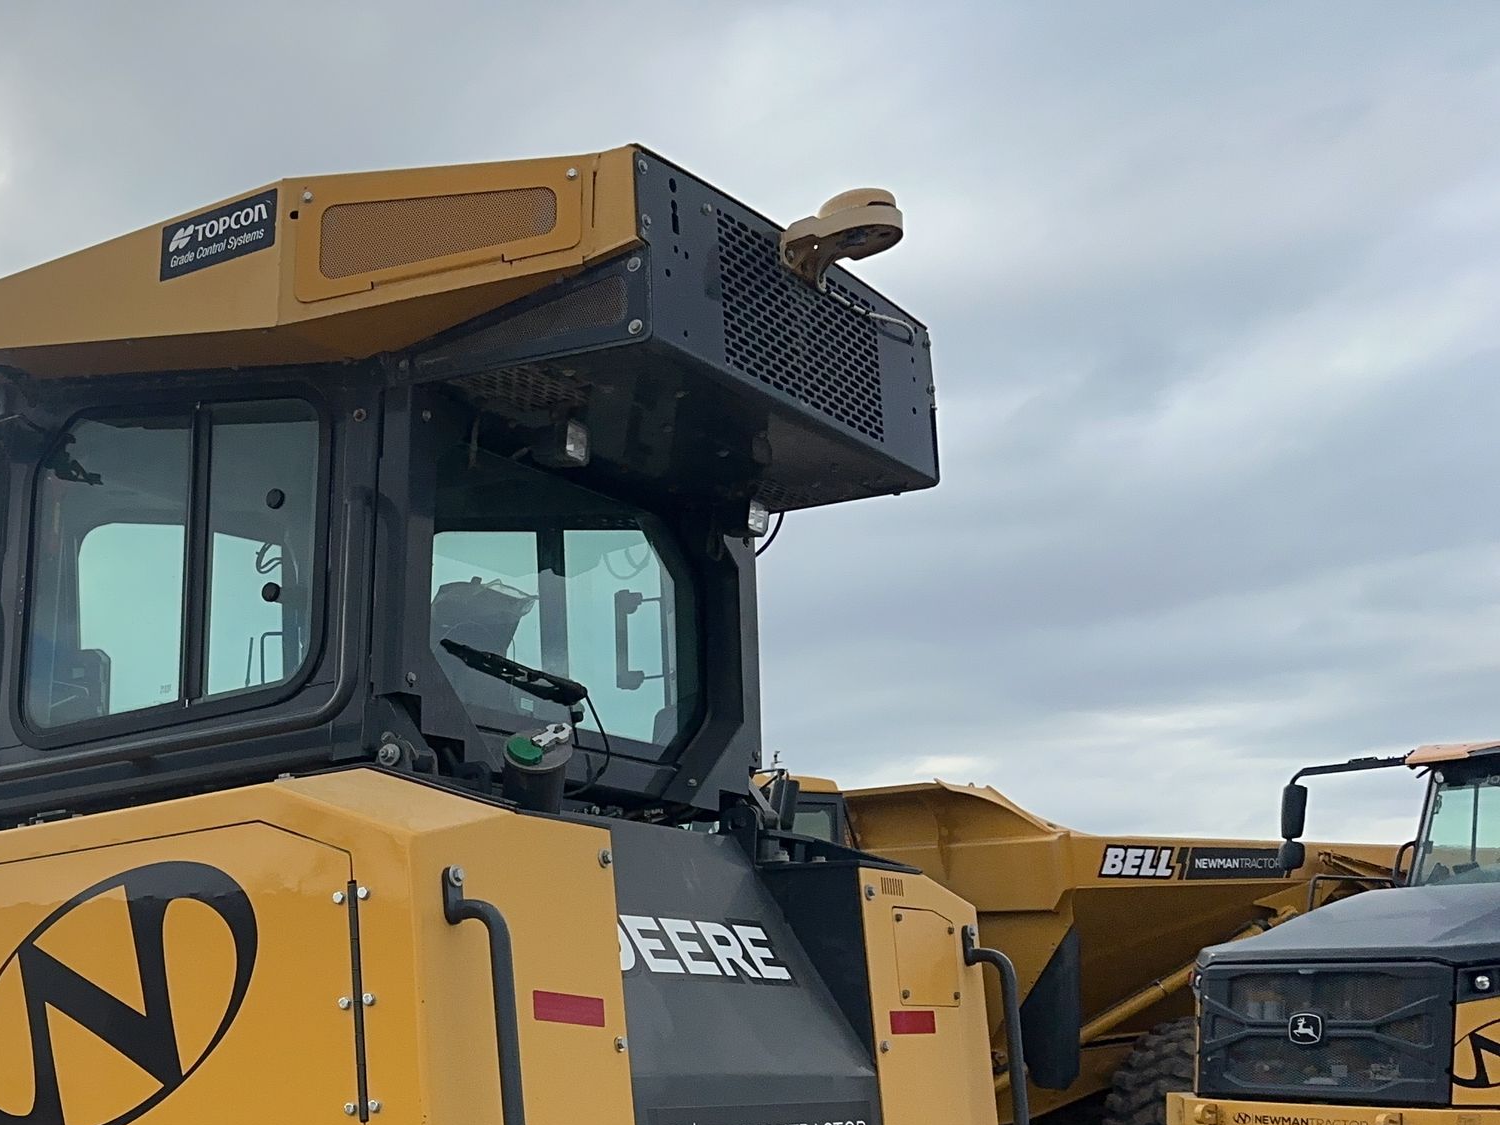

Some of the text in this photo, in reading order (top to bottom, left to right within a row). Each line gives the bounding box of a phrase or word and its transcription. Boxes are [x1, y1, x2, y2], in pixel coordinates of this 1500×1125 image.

[195, 203, 268, 241] TOPCON
[170, 228, 265, 268] Grade Control Systems
[1100, 846, 1172, 877] BELL
